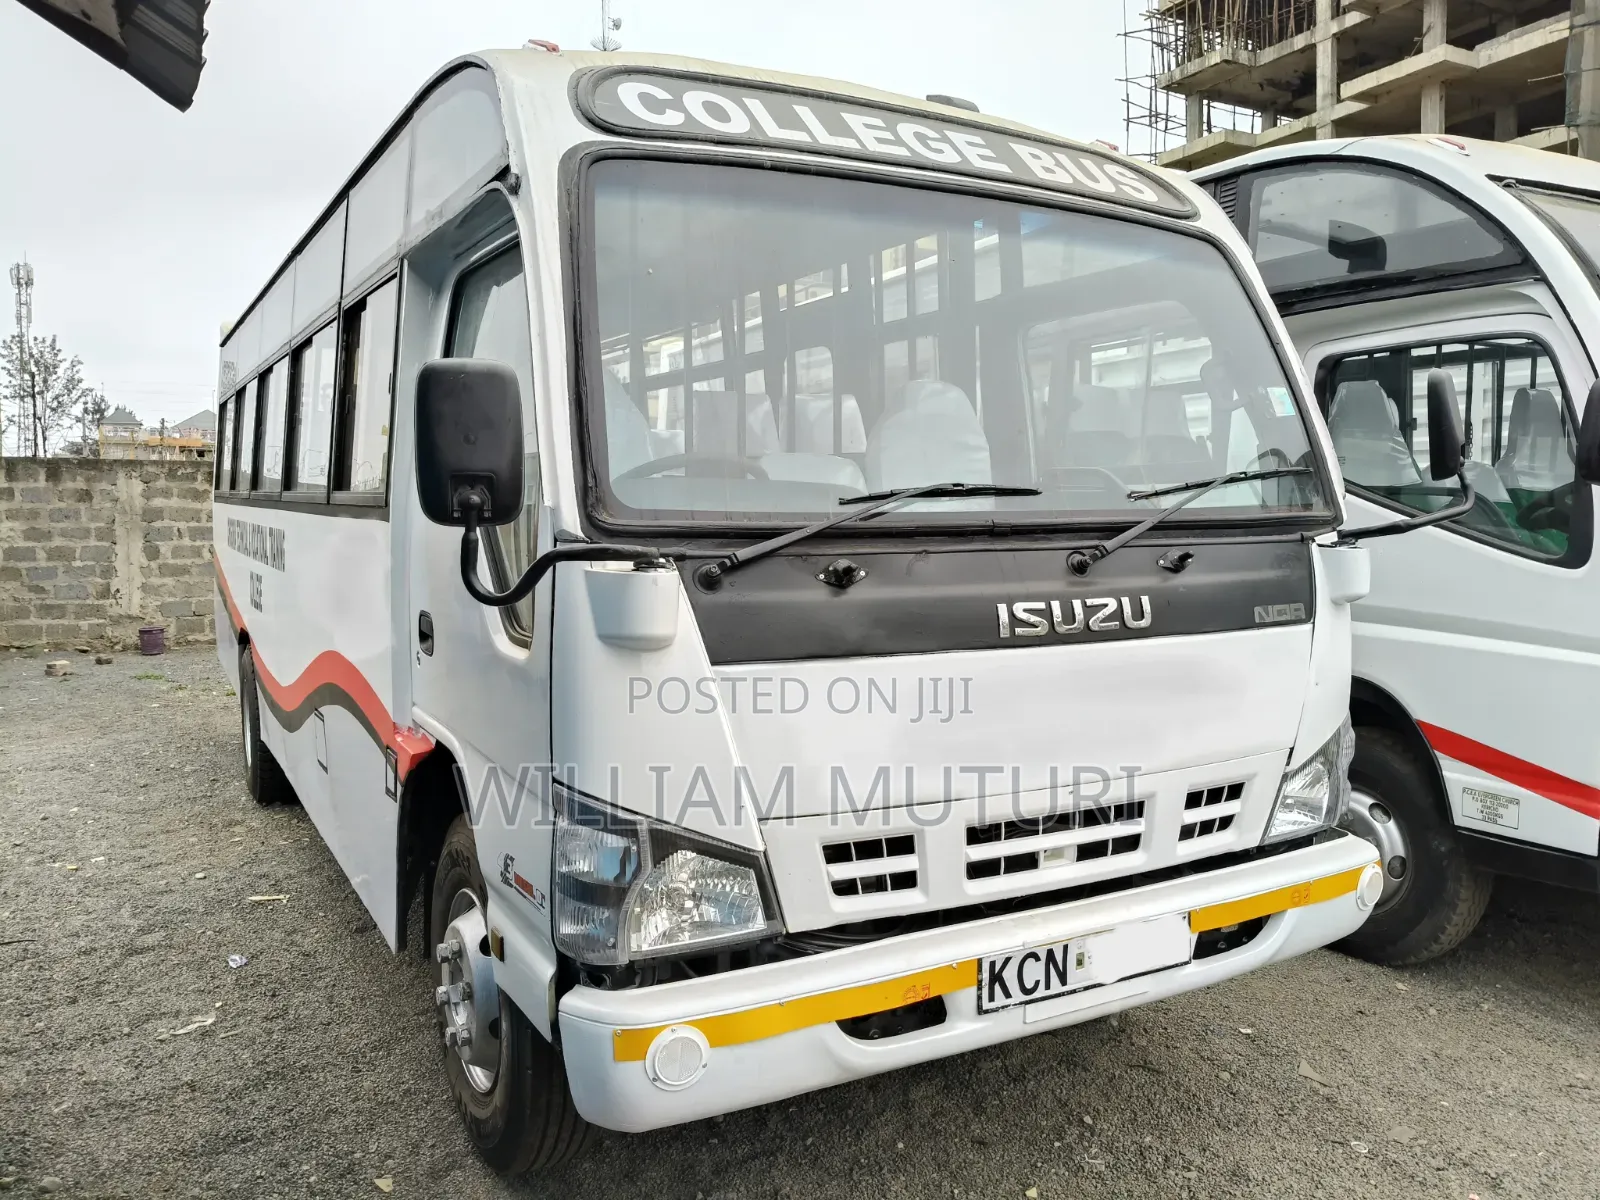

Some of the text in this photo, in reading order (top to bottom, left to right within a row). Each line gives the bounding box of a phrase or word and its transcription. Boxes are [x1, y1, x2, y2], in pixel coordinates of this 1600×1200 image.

[616, 81, 1160, 202] COLLEGE BUS
[996, 595, 1152, 638] ISUZU
[987, 943, 1070, 1003] KCN
